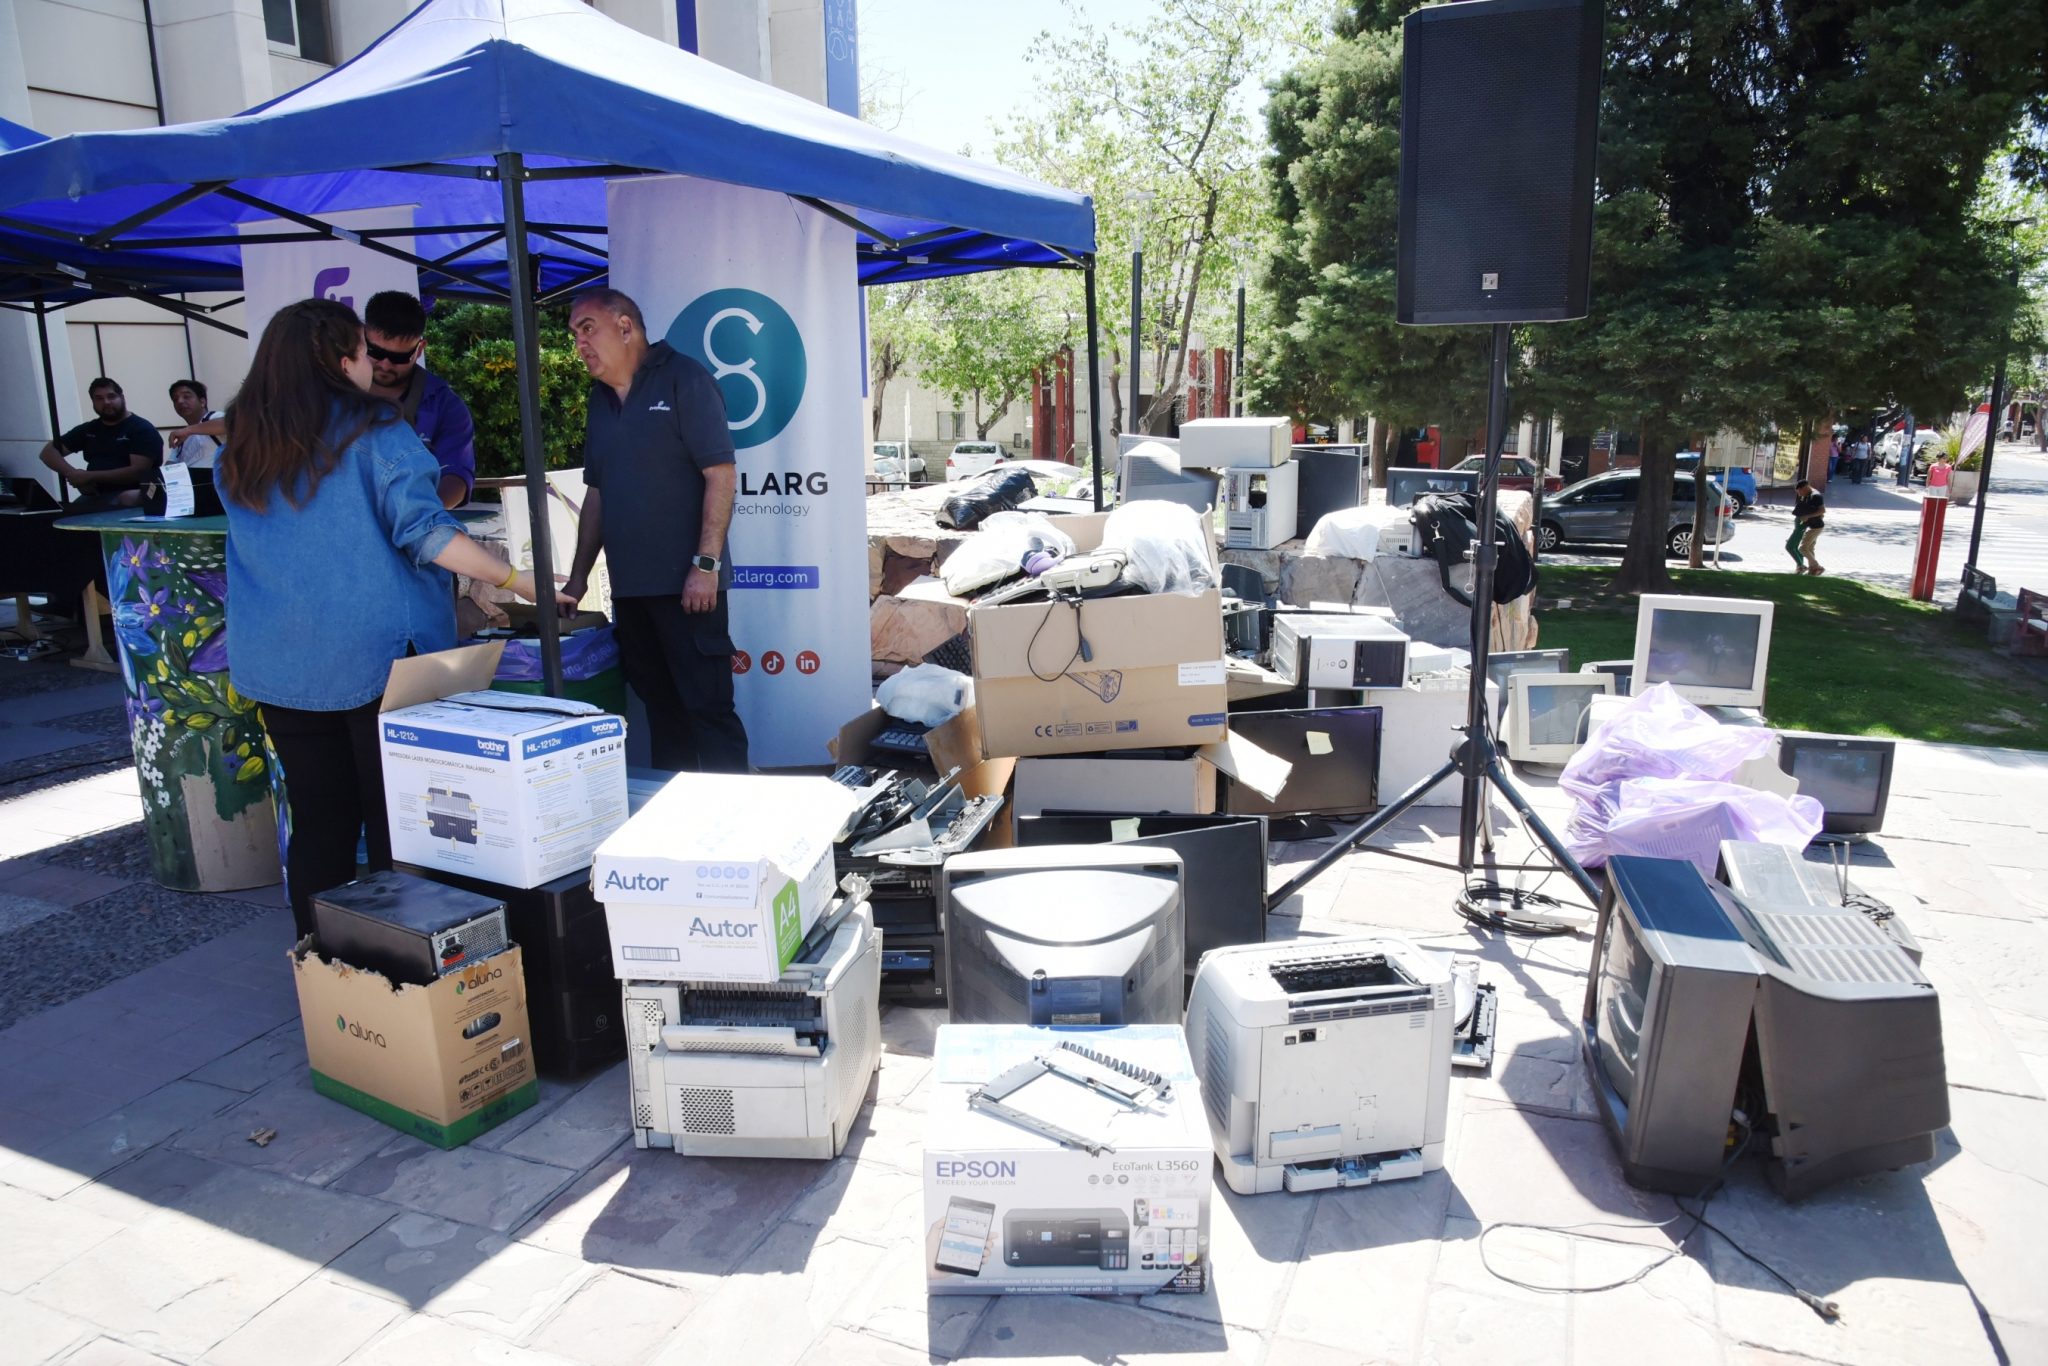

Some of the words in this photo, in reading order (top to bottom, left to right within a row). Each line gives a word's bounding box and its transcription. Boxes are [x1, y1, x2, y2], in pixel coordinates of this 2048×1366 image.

[736, 471, 829, 496] LARG
[733, 502, 811, 517] Technology
[732, 569, 808, 586] iclarg.com
[592, 721, 619, 733] brother
[477, 738, 506, 753] brother
[604, 869, 670, 892] Autor
[779, 890, 798, 937] A4
[688, 916, 758, 938] Autor
[467, 967, 503, 990] aluna
[349, 1020, 387, 1049] aluna
[936, 1160, 1016, 1178] EPSON
[1112, 1161, 1154, 1172] EcoTank
[1156, 1160, 1199, 1172] L3560
